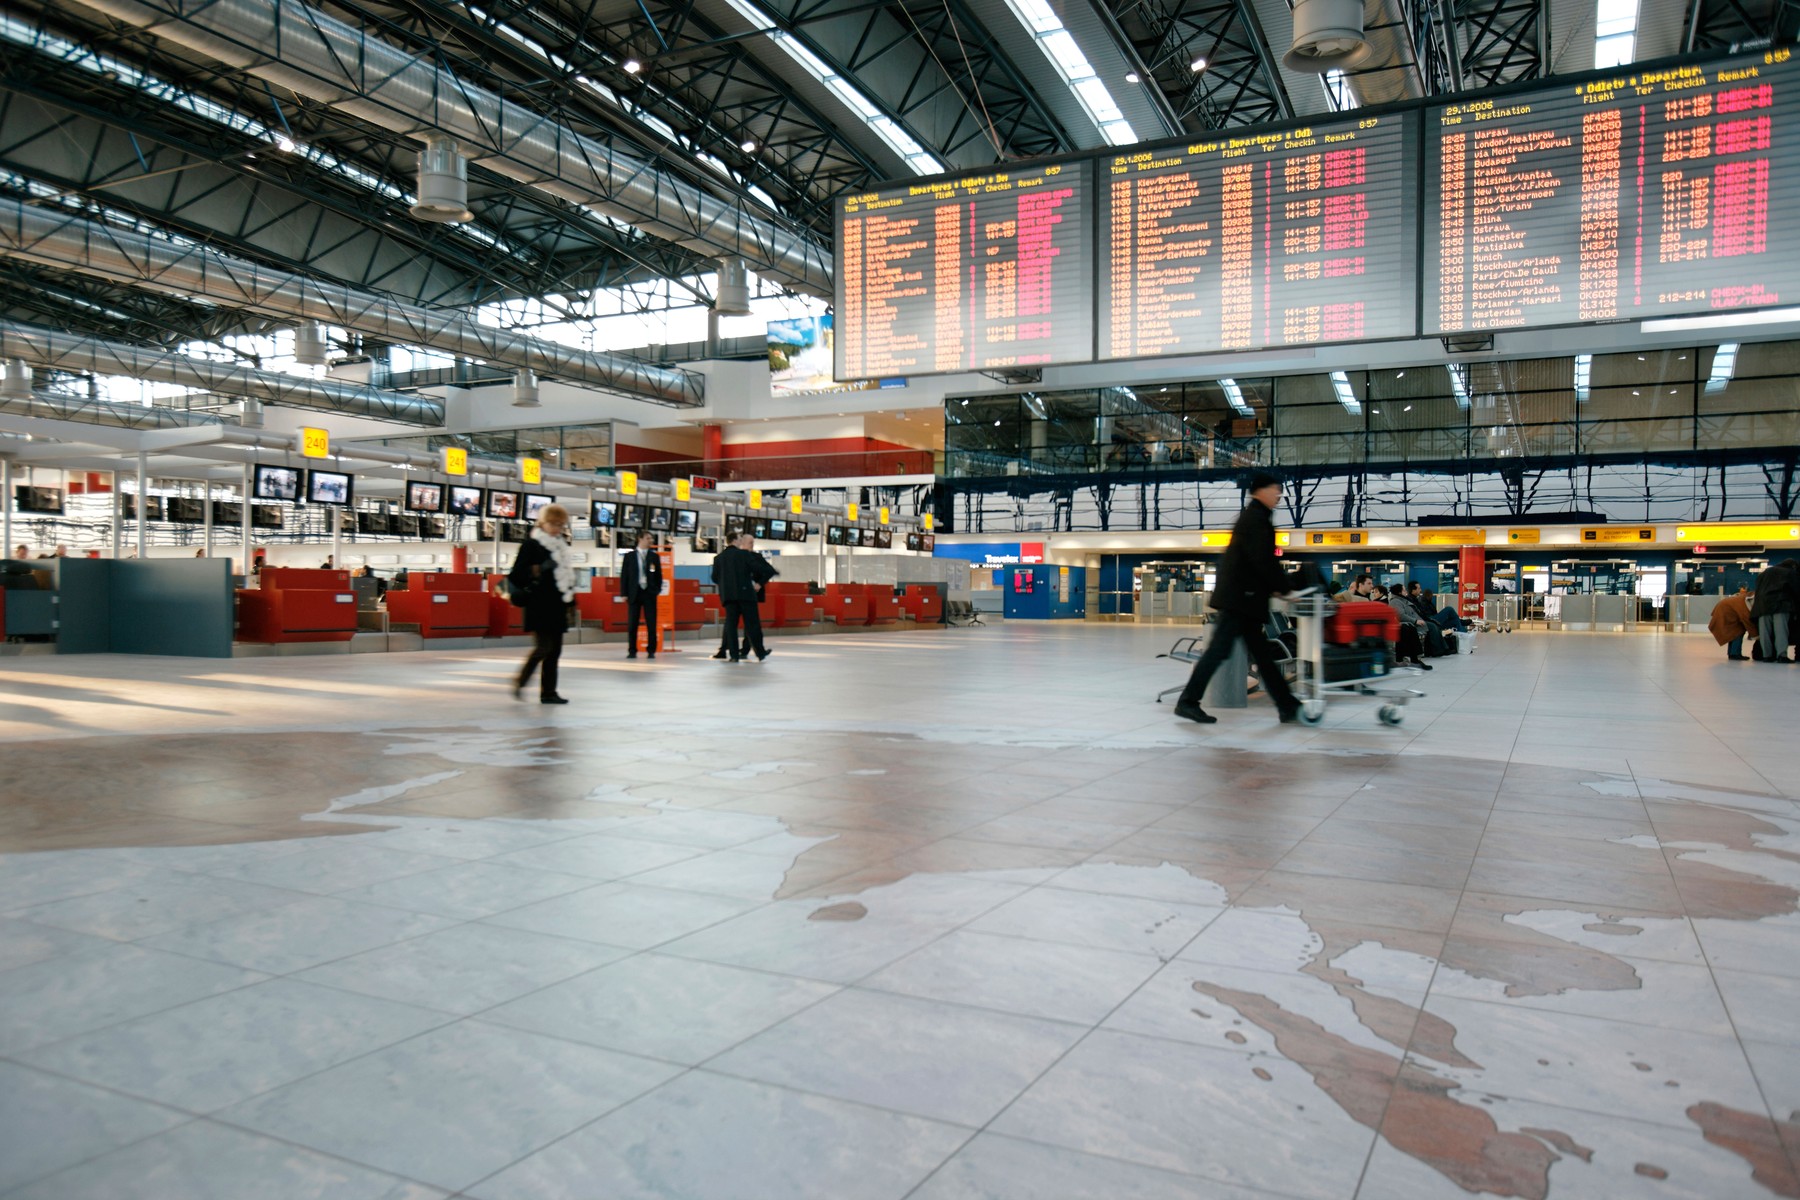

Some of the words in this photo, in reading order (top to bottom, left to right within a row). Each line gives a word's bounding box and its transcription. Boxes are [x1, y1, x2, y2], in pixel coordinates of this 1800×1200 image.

[1441, 116, 1461, 126] Time
[1475, 105, 1530, 120] Destination
[1583, 91, 1613, 103] Flight
[1635, 85, 1653, 95] Ter
[1664, 76, 1705, 90] Checkin
[1717, 66, 1759, 82] Remark
[1446, 103, 1492, 115] 29.1.2006
[1441, 135, 1465, 144] 12:25
[1474, 128, 1507, 139] Warsaw
[1582, 110, 1621, 122] AF4952
[1664, 96, 1711, 110] 141-157
[1716, 85, 1772, 102] CHECK-IN
[1441, 144, 1464, 153] 12:30
[1474, 130, 1554, 148] London/Heathrow
[1582, 120, 1621, 132] OK0650
[1664, 106, 1711, 120] 141-157
[1716, 96, 1771, 113] CHECK-IN
[1111, 165, 1127, 173] Time
[1138, 157, 1181, 170] Destination
[1222, 148, 1246, 158] Flight
[1284, 138, 1315, 148] Checkin
[1324, 132, 1354, 142] Remark
[1115, 153, 1151, 164] 29.1.2006
[1230, 133, 1281, 148] Departures
[1285, 154, 1321, 166] 141-157
[1324, 148, 1365, 160] CHECK-IN
[1440, 163, 1464, 172] 12:35
[1474, 155, 1516, 168] Budapest
[1582, 141, 1621, 152] MA6827
[1664, 127, 1710, 141] 141-157
[1715, 118, 1771, 134] CHECK-IN
[1440, 173, 1464, 182] 12:35
[1474, 167, 1506, 177] Krakow
[1582, 151, 1620, 162] AF4956
[1663, 138, 1710, 151] 141-157
[1715, 128, 1770, 144] CHECK-IN
[1441, 154, 1464, 163] 12:35
[1474, 150, 1488, 158] via
[1492, 138, 1571, 155] Montreal/Dorval
[1582, 131, 1621, 142] OK0108
[1440, 182, 1464, 191] 12:35
[1474, 170, 1552, 186] Helsinki/Vantaa
[1581, 161, 1620, 172] AY6880
[1662, 148, 1710, 161] 220-229
[1714, 139, 1770, 154] CHECK-IN
[844, 204, 858, 212] Time
[866, 198, 902, 209] Destination
[985, 183, 1011, 192] Checkin
[1018, 178, 1042, 187] Remark
[1440, 201, 1464, 210] 12:45
[1473, 189, 1554, 205] Oslo/Gardermoen
[1581, 181, 1620, 192] OK0446
[1661, 172, 1681, 182] 220
[1714, 160, 1769, 175] CHECK-IN
[1440, 192, 1464, 200] 12:40
[1474, 188, 1490, 196] New
[1494, 179, 1560, 193] York/J.F.Kenn
[1581, 171, 1620, 182] DL8742
[1440, 211, 1464, 219] 12:45
[1473, 202, 1531, 215] Brno/Turany
[1581, 191, 1619, 202] AF4966
[1662, 179, 1709, 192] 141-157
[1713, 171, 1769, 185] CHECK-IN
[1137, 220, 1158, 228] Sofia
[1285, 199, 1320, 210] 141-157
[1324, 193, 1364, 205] CHECK-IN
[1440, 220, 1464, 228] 12:45
[1473, 215, 1501, 224] Zilina
[1581, 201, 1619, 212] AF4964
[1662, 190, 1708, 202] 141-157
[1713, 182, 1768, 196] CHECK-IN
[1440, 229, 1464, 237] 12:50
[1473, 224, 1510, 234] Ostrava
[1580, 211, 1619, 221] AF4932
[1662, 200, 1708, 212] 141-157
[1713, 192, 1768, 206] CHECK-IN
[1440, 239, 1464, 247] 12:50
[1473, 231, 1526, 243] Manchester
[1580, 221, 1619, 231] MA7644
[1661, 210, 1708, 222] 141-157
[1712, 203, 1767, 216] CHECK-IN
[1440, 248, 1463, 256] 12:55
[1473, 241, 1523, 252] Bratislava
[1580, 231, 1618, 241] AF4910
[1661, 221, 1707, 232] 141-157
[1712, 214, 1767, 227] CHECK-IN
[1440, 257, 1463, 265] 13:00
[1473, 253, 1502, 262] Munich
[1580, 241, 1618, 251] LH3271
[1660, 234, 1680, 242] 250
[1712, 224, 1767, 237] CHECK-IN
[1473, 257, 1560, 271] Stockholm/Arlanda
[1580, 251, 1618, 260] OK0490
[1659, 241, 1707, 252] 220-229
[1711, 235, 1766, 247] CHECK-IN
[1439, 285, 1463, 293] 13:10
[1472, 277, 1543, 290] Rome/Fiumicino
[1579, 271, 1617, 280] OK4728
[1440, 276, 1463, 284] 13:05
[1472, 269, 1529, 280] Paris/Ch.De
[1579, 261, 1618, 270] AF4903
[1659, 252, 1706, 262] 212-214
[1711, 245, 1766, 257] CHECK-IN
[1472, 286, 1560, 299] Stockholm/Arlanda
[1579, 280, 1617, 290] SK1768
[1472, 299, 1513, 308] Porlamar
[1579, 290, 1617, 299] OK6036
[1472, 308, 1521, 318] Amsterdam
[1579, 300, 1617, 309] KL3124
[1658, 292, 1705, 302] 212-214
[1710, 287, 1764, 298] CHECK-IN
[1489, 317, 1525, 326] Olomouc
[1578, 310, 1616, 318] OK4006
[306, 436, 326, 450] 240
[449, 456, 464, 468] 241
[524, 466, 538, 477] 242
